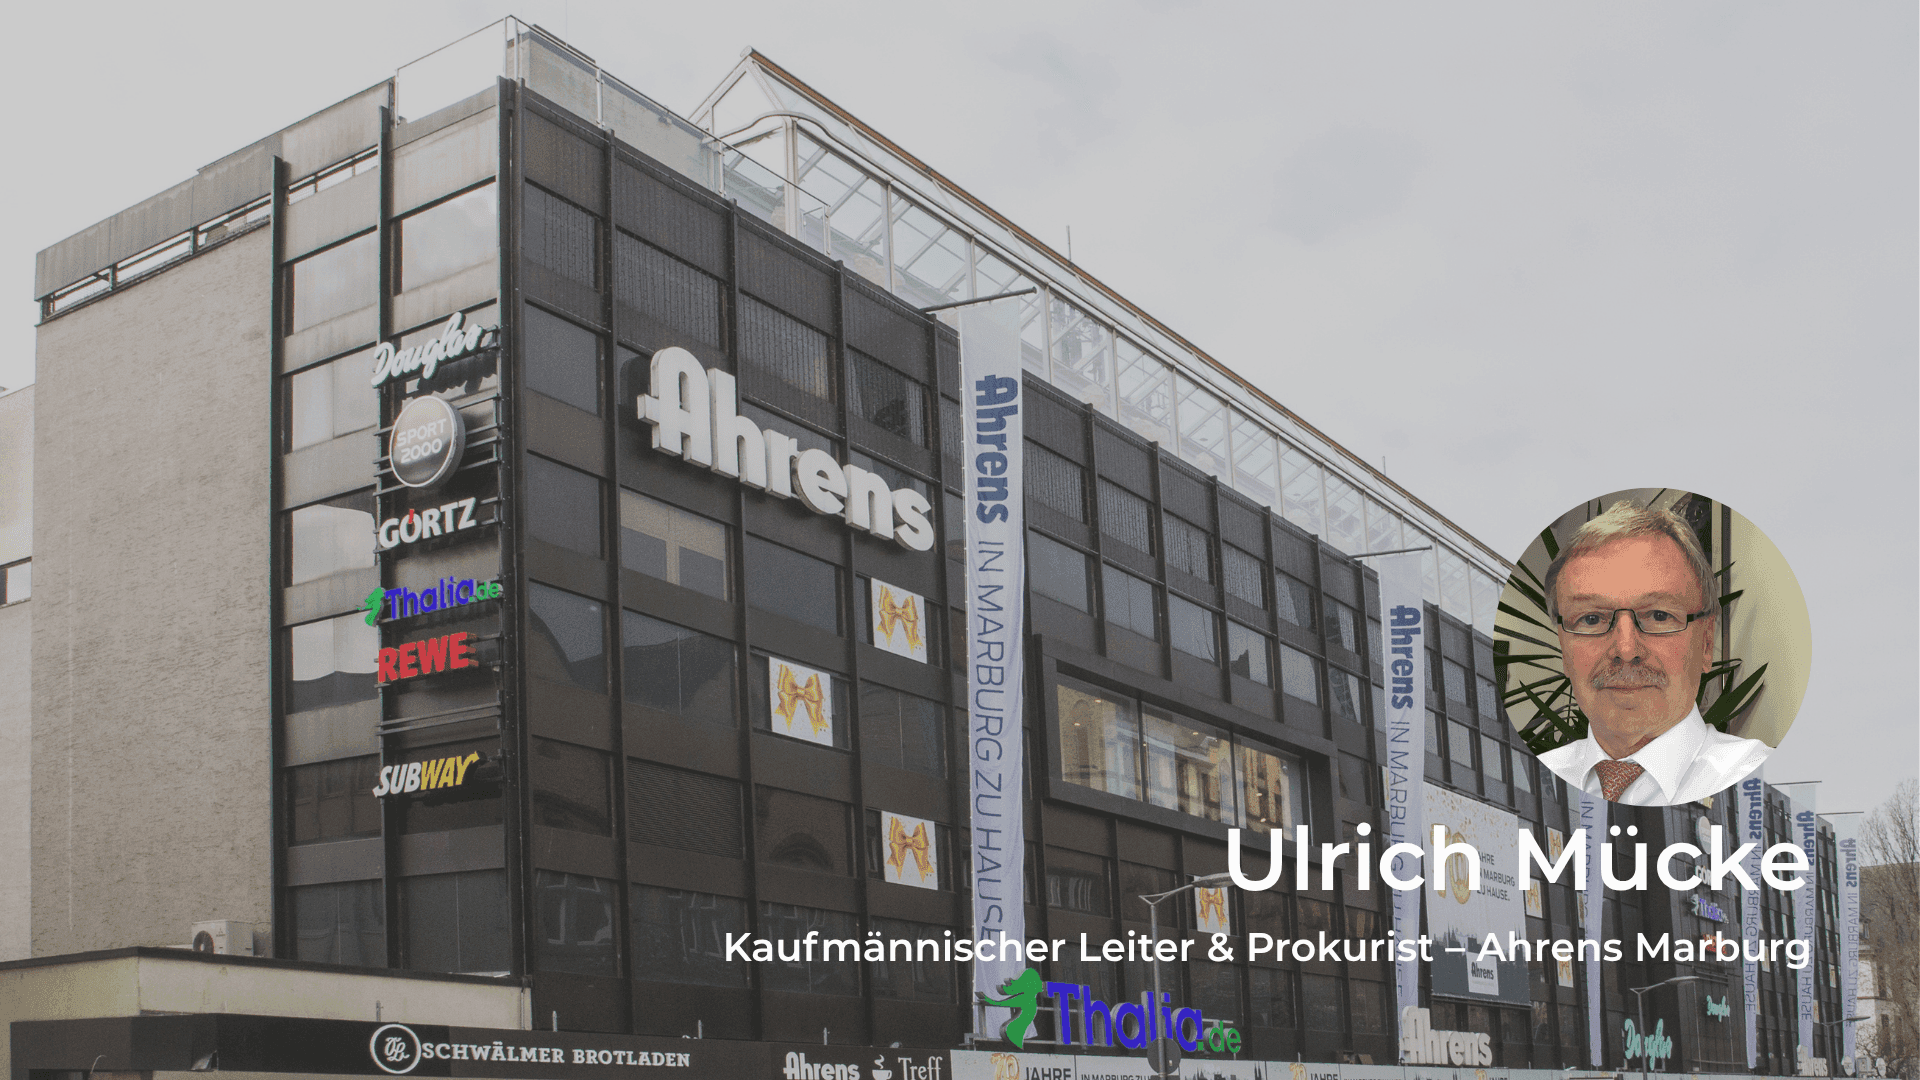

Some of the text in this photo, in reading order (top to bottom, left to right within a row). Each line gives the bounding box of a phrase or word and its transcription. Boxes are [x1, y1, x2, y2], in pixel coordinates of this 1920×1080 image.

[396, 418, 448, 448] SPORT
[400, 438, 443, 465] 2000
[637, 346, 934, 552] Ahrens
[976, 374, 1019, 524] Ahrens
[978, 540, 1005, 573] IN
[378, 632, 479, 683] REWE
[975, 585, 1005, 762] MARBURG
[1389, 604, 1421, 710] Ahrens
[1390, 721, 1410, 744] IN
[372, 751, 480, 798] SUBWAY
[975, 769, 1003, 817] ZU
[1483, 868, 1516, 887] MARBURG
[1471, 962, 1495, 980] Ahrens
[421, 1041, 566, 1064] SCHWÄLMER
[572, 1049, 691, 1068] BROTLADEN
[1401, 1006, 1493, 1066] Ahrens
[783, 1051, 943, 1080] Ahrens Treff
